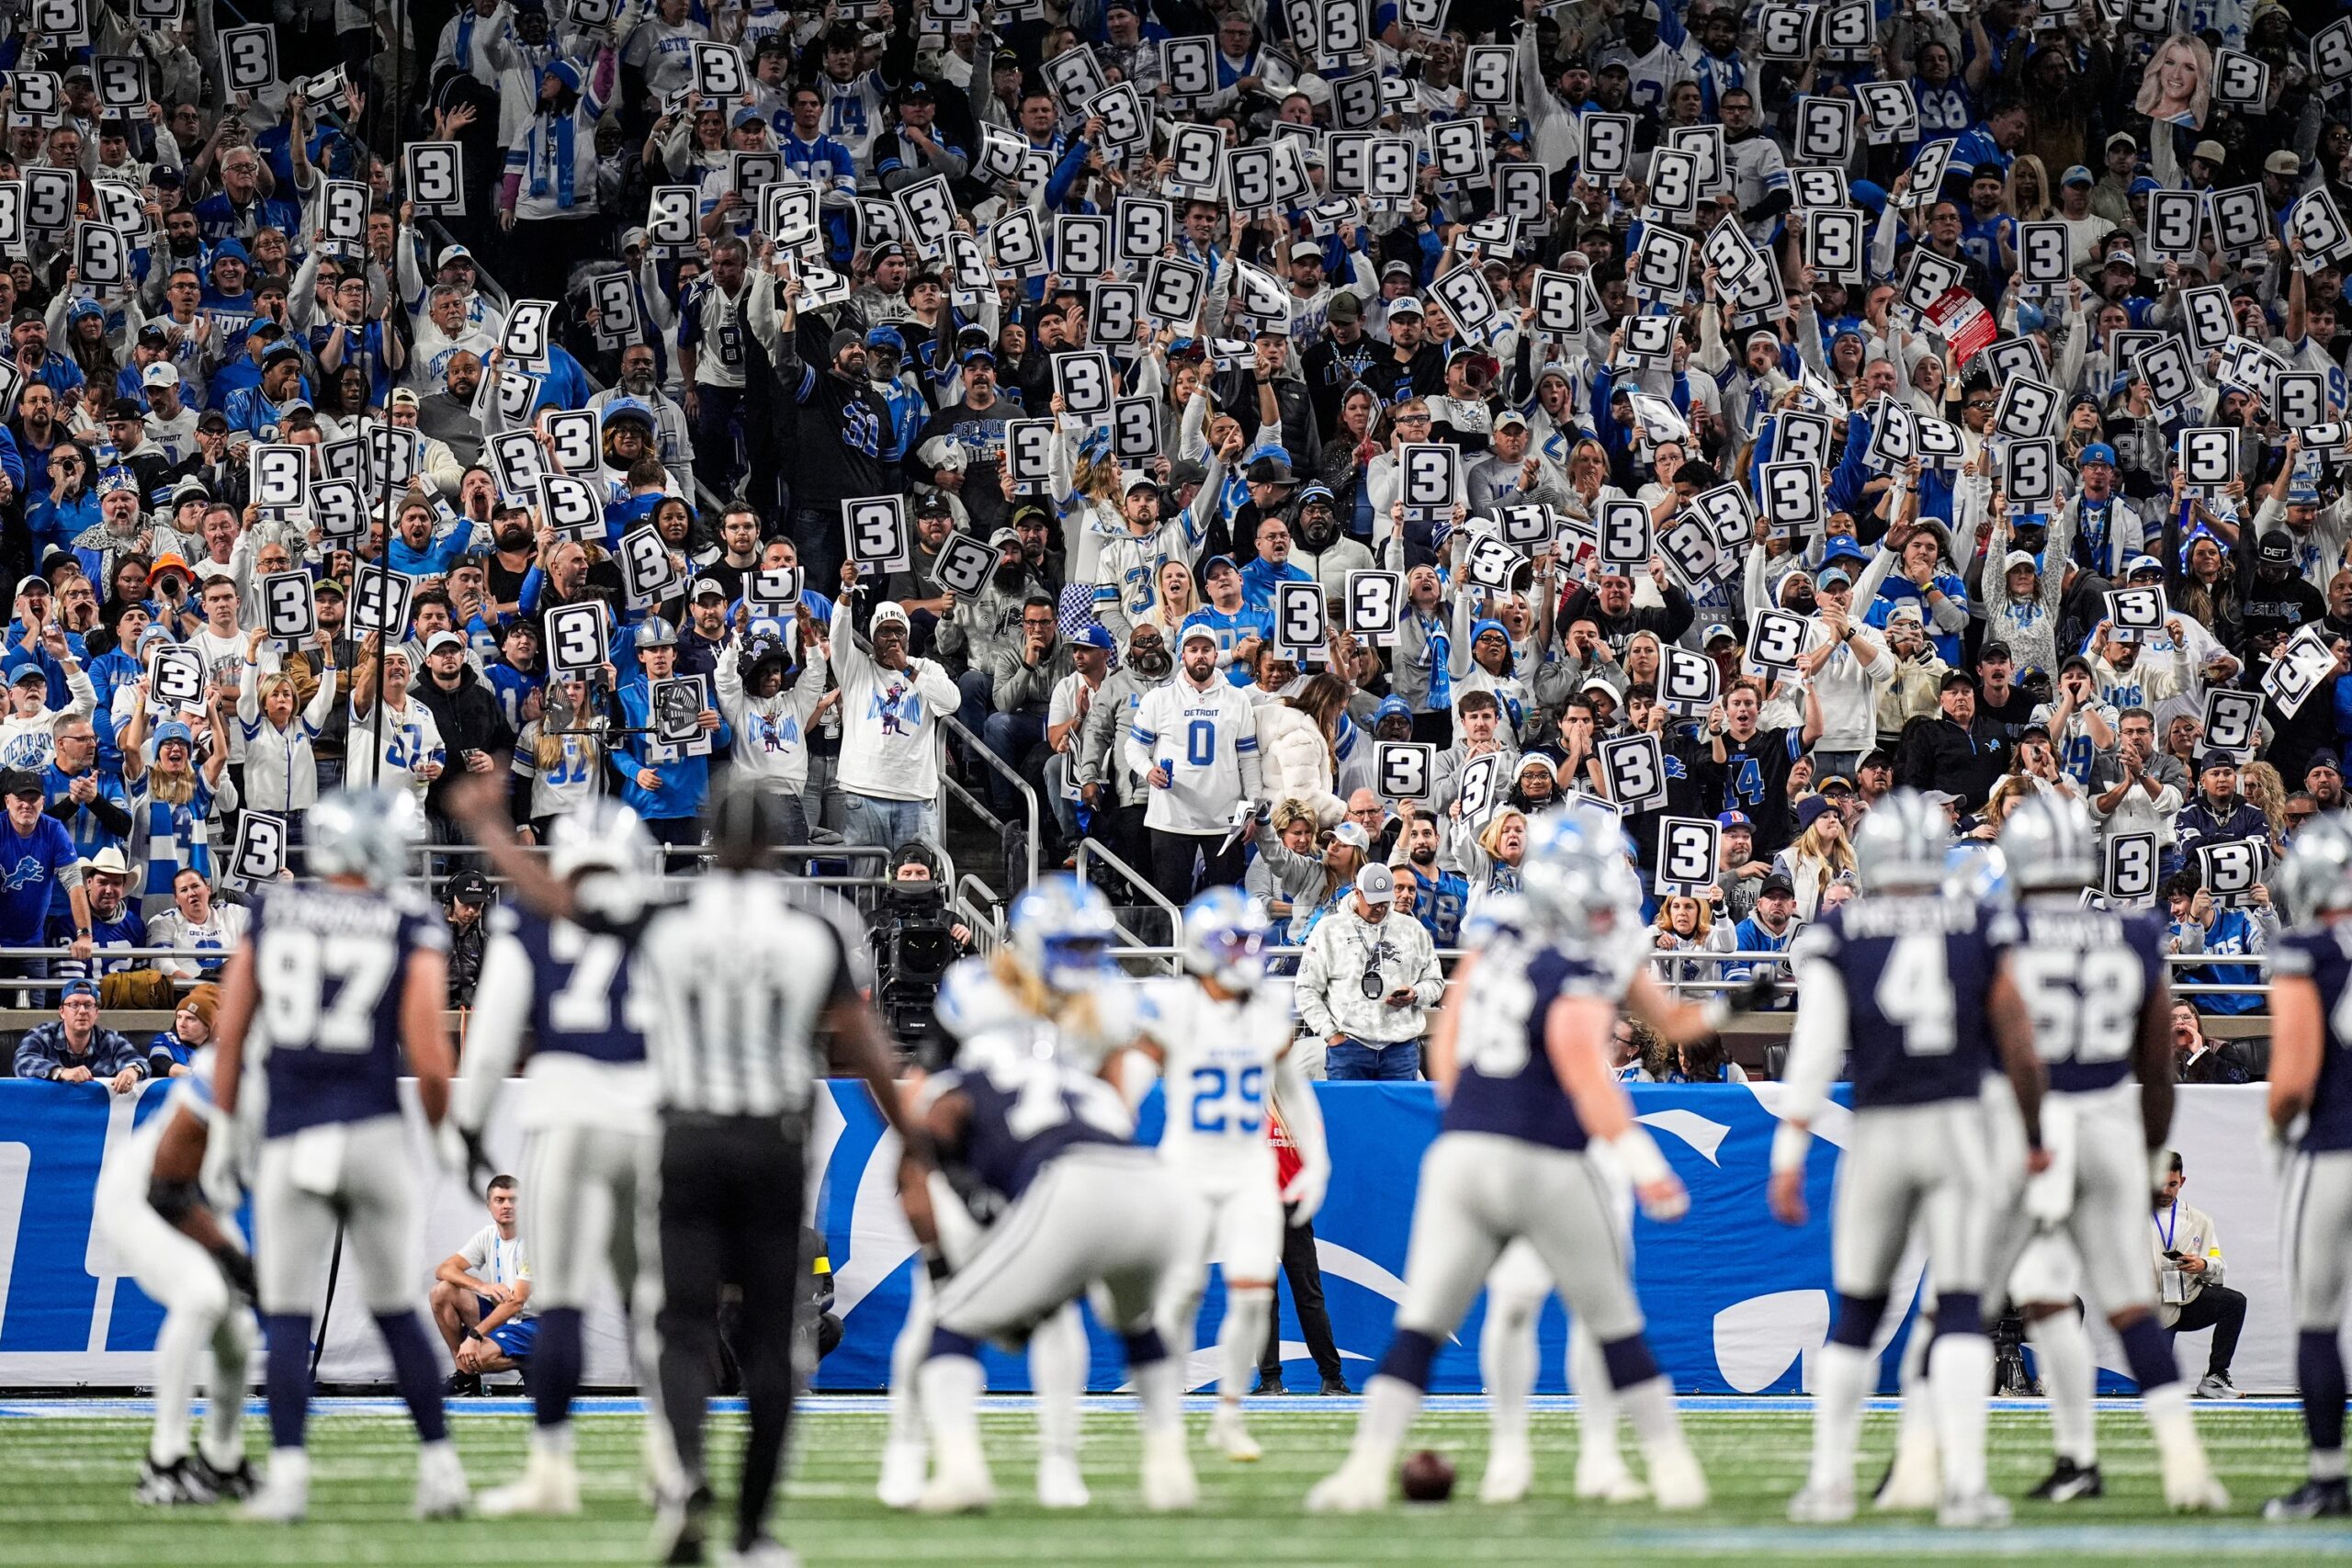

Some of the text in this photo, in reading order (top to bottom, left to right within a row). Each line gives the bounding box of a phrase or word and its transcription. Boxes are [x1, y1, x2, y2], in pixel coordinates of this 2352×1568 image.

[1290, 3, 1316, 43] 3
[1327, 3, 1359, 48] 3
[1834, 6, 1864, 42] 3
[233, 35, 267, 83] 3
[704, 50, 737, 92] 3
[1172, 45, 1206, 91] 3
[1476, 51, 1506, 99] 3
[2319, 30, 2352, 76] 3
[21, 72, 51, 108] 3
[107, 60, 139, 101] 3
[1056, 58, 1094, 107] 3
[2228, 58, 2257, 98] 3
[1097, 93, 1136, 138] 3
[1344, 82, 1374, 125] 3
[1871, 85, 1906, 129] 3
[1441, 128, 1474, 175] 3
[1590, 121, 1623, 169] 3
[1808, 107, 1843, 152] 3
[417, 151, 452, 198] 3
[991, 139, 1021, 176] 3
[1178, 132, 1213, 182] 3
[1237, 154, 1268, 203] 3
[1338, 140, 1364, 187] 3
[1378, 149, 1407, 193] 3
[1913, 149, 1941, 188] 3
[34, 175, 65, 227] 3
[742, 160, 774, 204] 3
[1508, 171, 1541, 221] 3
[1654, 155, 1688, 207] 3
[1804, 173, 1837, 204] 3
[108, 186, 138, 230] 3
[331, 187, 360, 239] 3
[661, 193, 690, 242] 3
[779, 195, 812, 243] 3
[870, 207, 900, 243] 3
[910, 187, 950, 239] 3
[1128, 207, 1161, 254] 3
[2160, 198, 2192, 245] 3
[2224, 196, 2259, 243] 3
[2305, 204, 2336, 251] 3
[86, 231, 118, 279] 3
[959, 232, 988, 288] 3
[998, 217, 1033, 262] 3
[1066, 224, 1099, 272] 3
[1645, 236, 1680, 279] 3
[1710, 231, 1746, 277] 3
[1818, 218, 1851, 265] 3
[2030, 230, 2062, 277] 3
[603, 281, 632, 329] 3
[1159, 269, 1192, 316] 3
[1452, 276, 1488, 324] 3
[1542, 281, 1574, 327] 3
[1916, 265, 1950, 309] 3
[509, 306, 540, 354] 3
[1103, 291, 1133, 338] 3
[1634, 318, 1667, 351] 3
[2194, 294, 2228, 342] 3
[1066, 359, 1102, 409] 3
[2148, 353, 2187, 398] 3
[2007, 386, 2047, 435] 3
[2284, 379, 2316, 426] 3
[555, 418, 589, 466] 3
[1018, 426, 1049, 477] 3
[1121, 404, 1153, 453] 3
[1789, 422, 1821, 459] 3
[1886, 412, 1908, 457] 3
[1921, 424, 1953, 452] 3
[261, 453, 298, 502] 3
[501, 440, 537, 487] 3
[1412, 453, 1447, 502] 3
[2015, 446, 2046, 496] 3
[2192, 434, 2227, 479] 3
[325, 487, 356, 531] 3
[552, 480, 585, 520] 3
[1711, 494, 1746, 538] 3
[1774, 469, 1811, 520] 3
[857, 505, 895, 555] 3
[1505, 504, 1540, 537] 3
[1610, 508, 1643, 557] 3
[634, 537, 668, 589] 3
[945, 547, 988, 589] 3
[1476, 541, 1512, 581] 3
[1673, 531, 1708, 576] 3
[2264, 547, 2288, 558] DET
[273, 581, 307, 632] 3
[1288, 591, 1319, 641] 3
[1357, 579, 1391, 627] 3
[2119, 592, 2155, 623] 3
[559, 612, 595, 663] 3
[1760, 616, 1800, 663] 3
[164, 663, 198, 698] 3
[1672, 652, 1708, 696] 3
[1184, 708, 1219, 717] DETROIT
[2214, 698, 2248, 744] 3
[4, 732, 54, 763] DETROIT
[1188, 720, 1215, 765] 0
[1386, 749, 1423, 793] 3
[1462, 764, 1488, 815] 3
[1615, 744, 1654, 797] 3
[1723, 758, 1765, 810] 14
[244, 823, 277, 874] 3
[1671, 827, 1709, 878] 3
[2119, 840, 2149, 891] 3
[2213, 845, 2251, 888] 3
[1874, 931, 1958, 1057] 4
[2016, 946, 2145, 1065] 52
